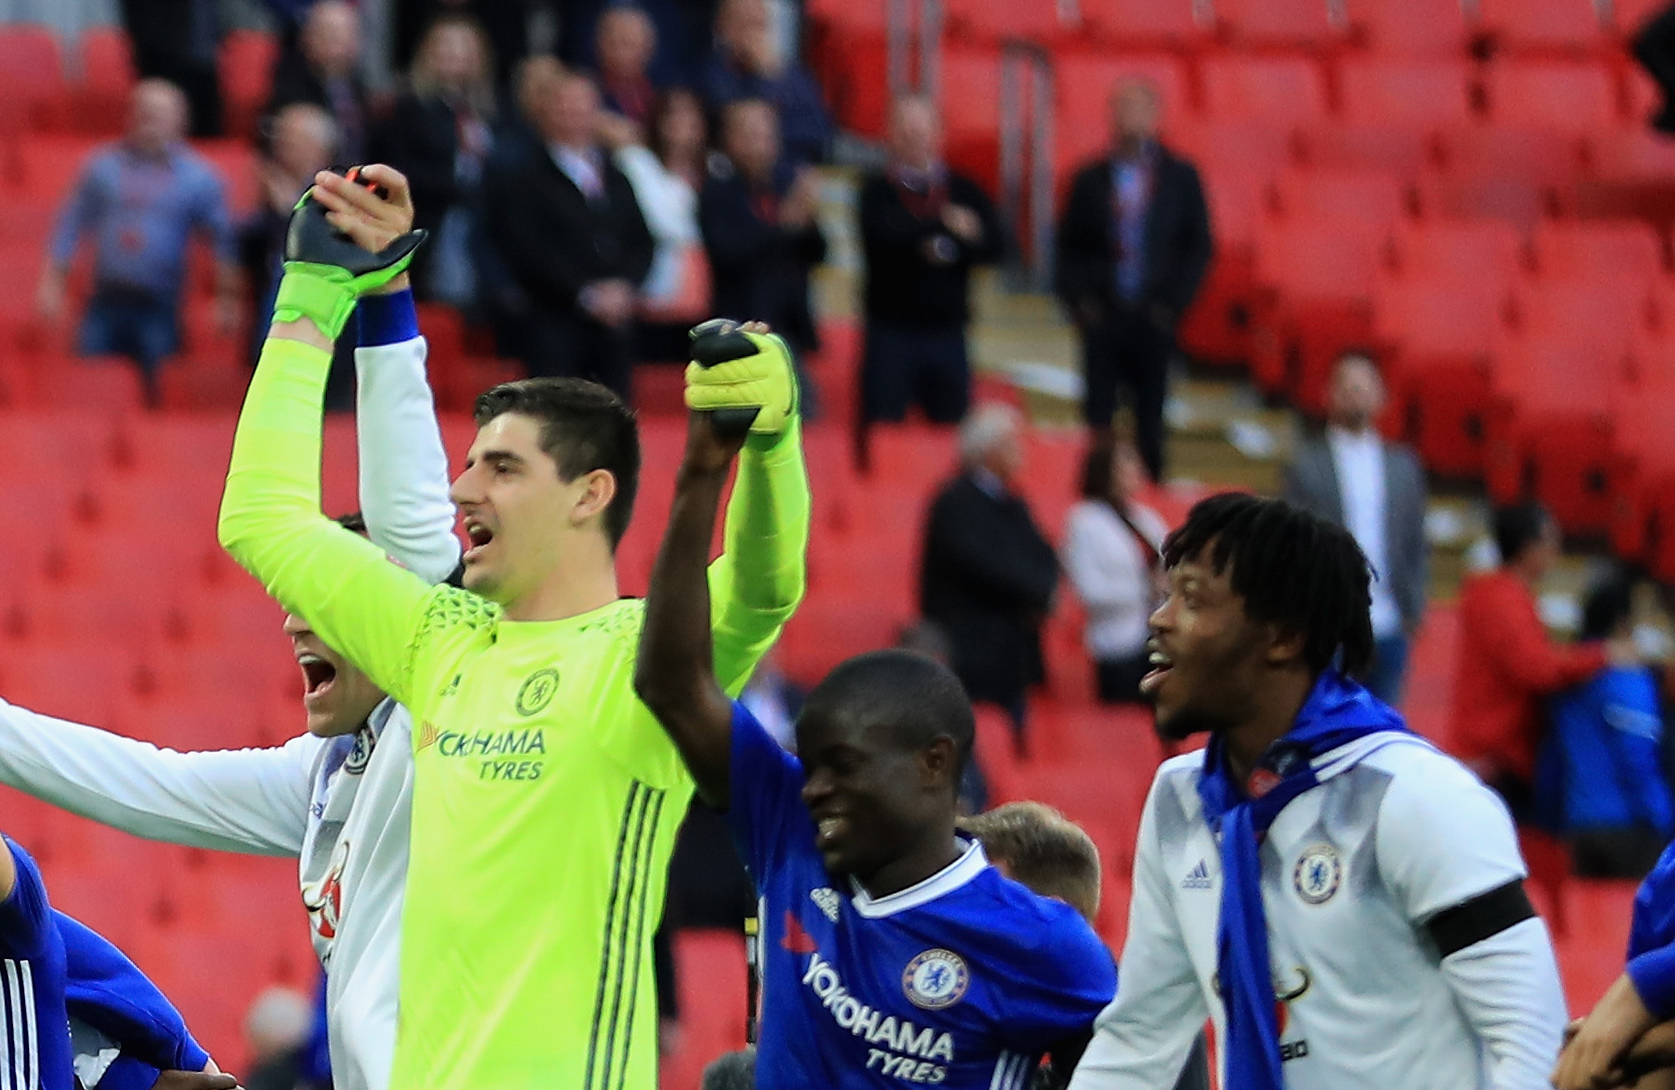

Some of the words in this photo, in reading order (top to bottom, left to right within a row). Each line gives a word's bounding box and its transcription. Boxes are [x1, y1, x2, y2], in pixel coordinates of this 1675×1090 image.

[479, 761, 543, 780] TYRES
[802, 952, 954, 1064] YOKOHAMA
[866, 1048, 946, 1085] TYRES
